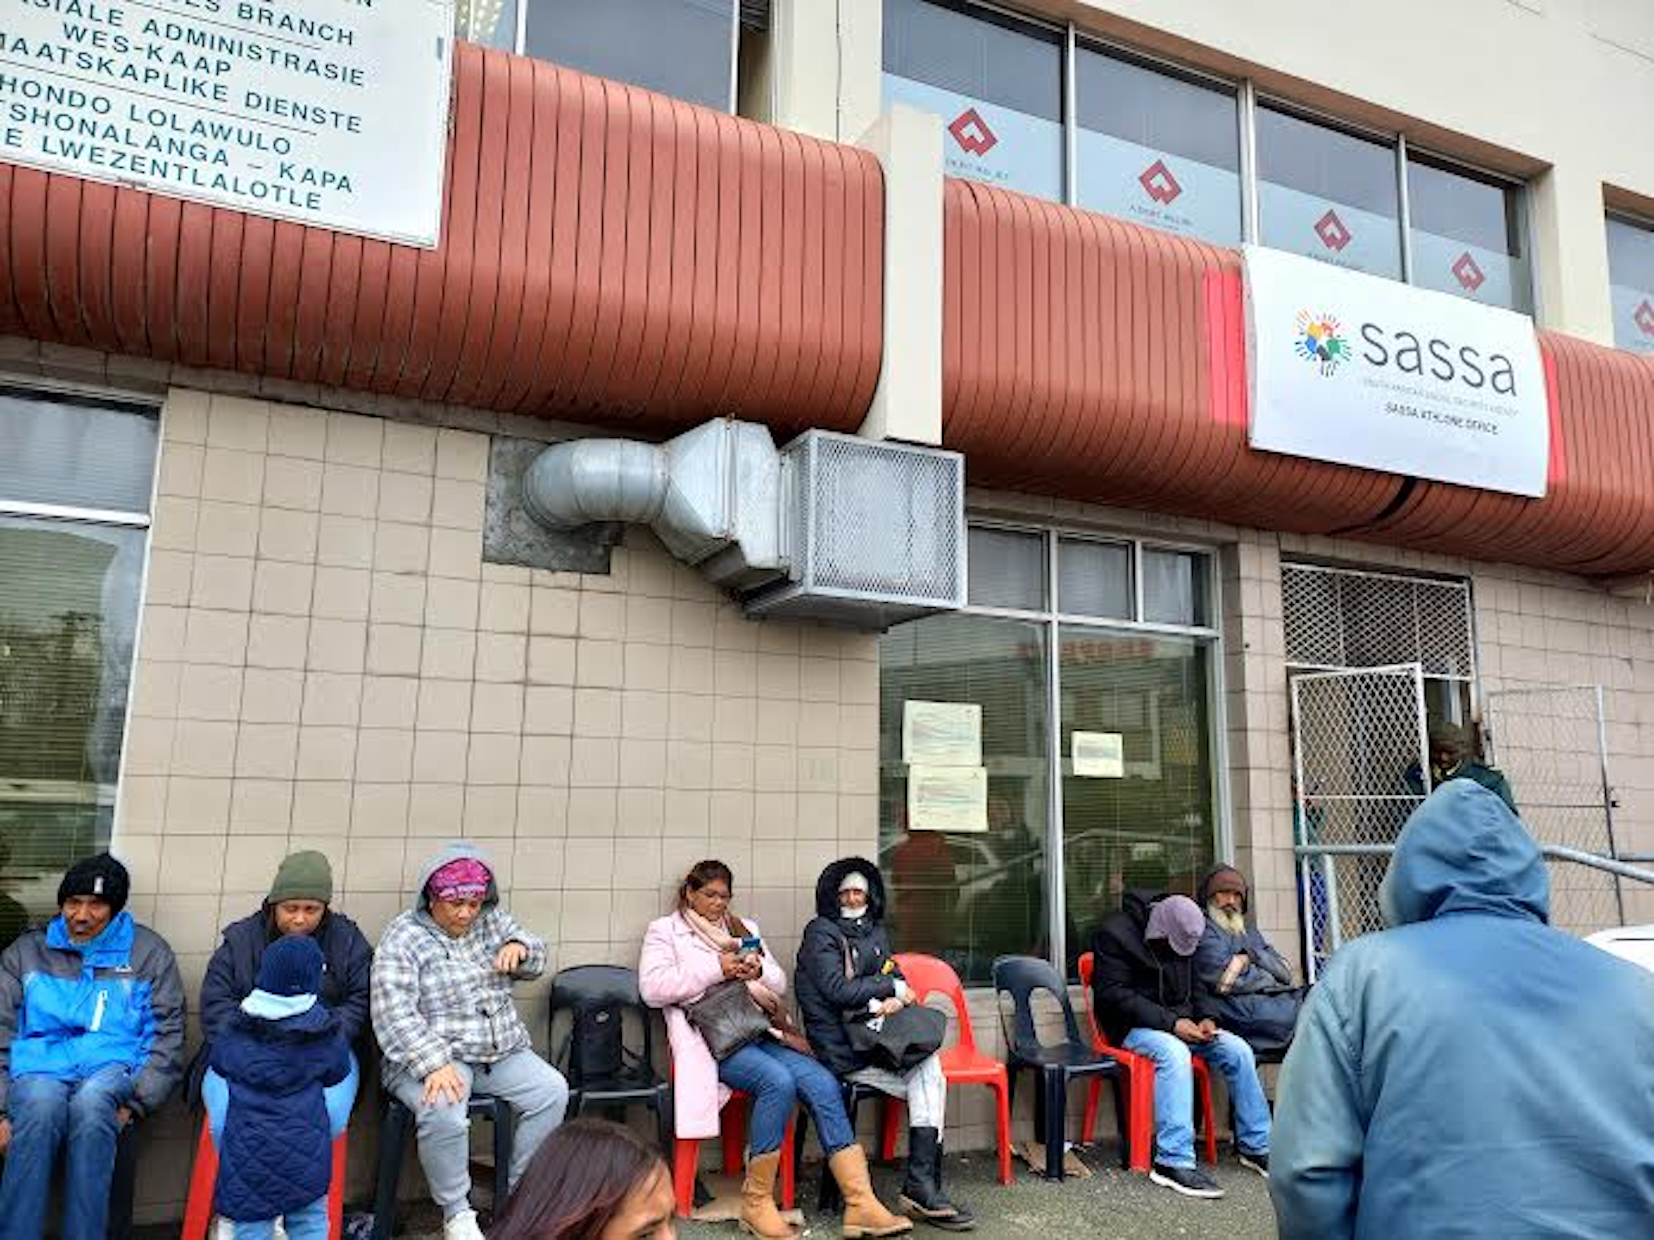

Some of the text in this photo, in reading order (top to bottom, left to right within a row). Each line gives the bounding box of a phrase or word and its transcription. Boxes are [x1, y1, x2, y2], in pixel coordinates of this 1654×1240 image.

[63, 21, 232, 77] WES-KAAP
[238, 2, 354, 46] BRANCH
[142, 18, 366, 87] ADMINISTRASIE
[130, 104, 291, 155] LOLAWULO
[245, 91, 362, 134] DIENSTE
[42, 135, 322, 210] LWEZENTLALOTLE
[279, 161, 353, 193] KAPA
[1361, 322, 1517, 397] sassa
